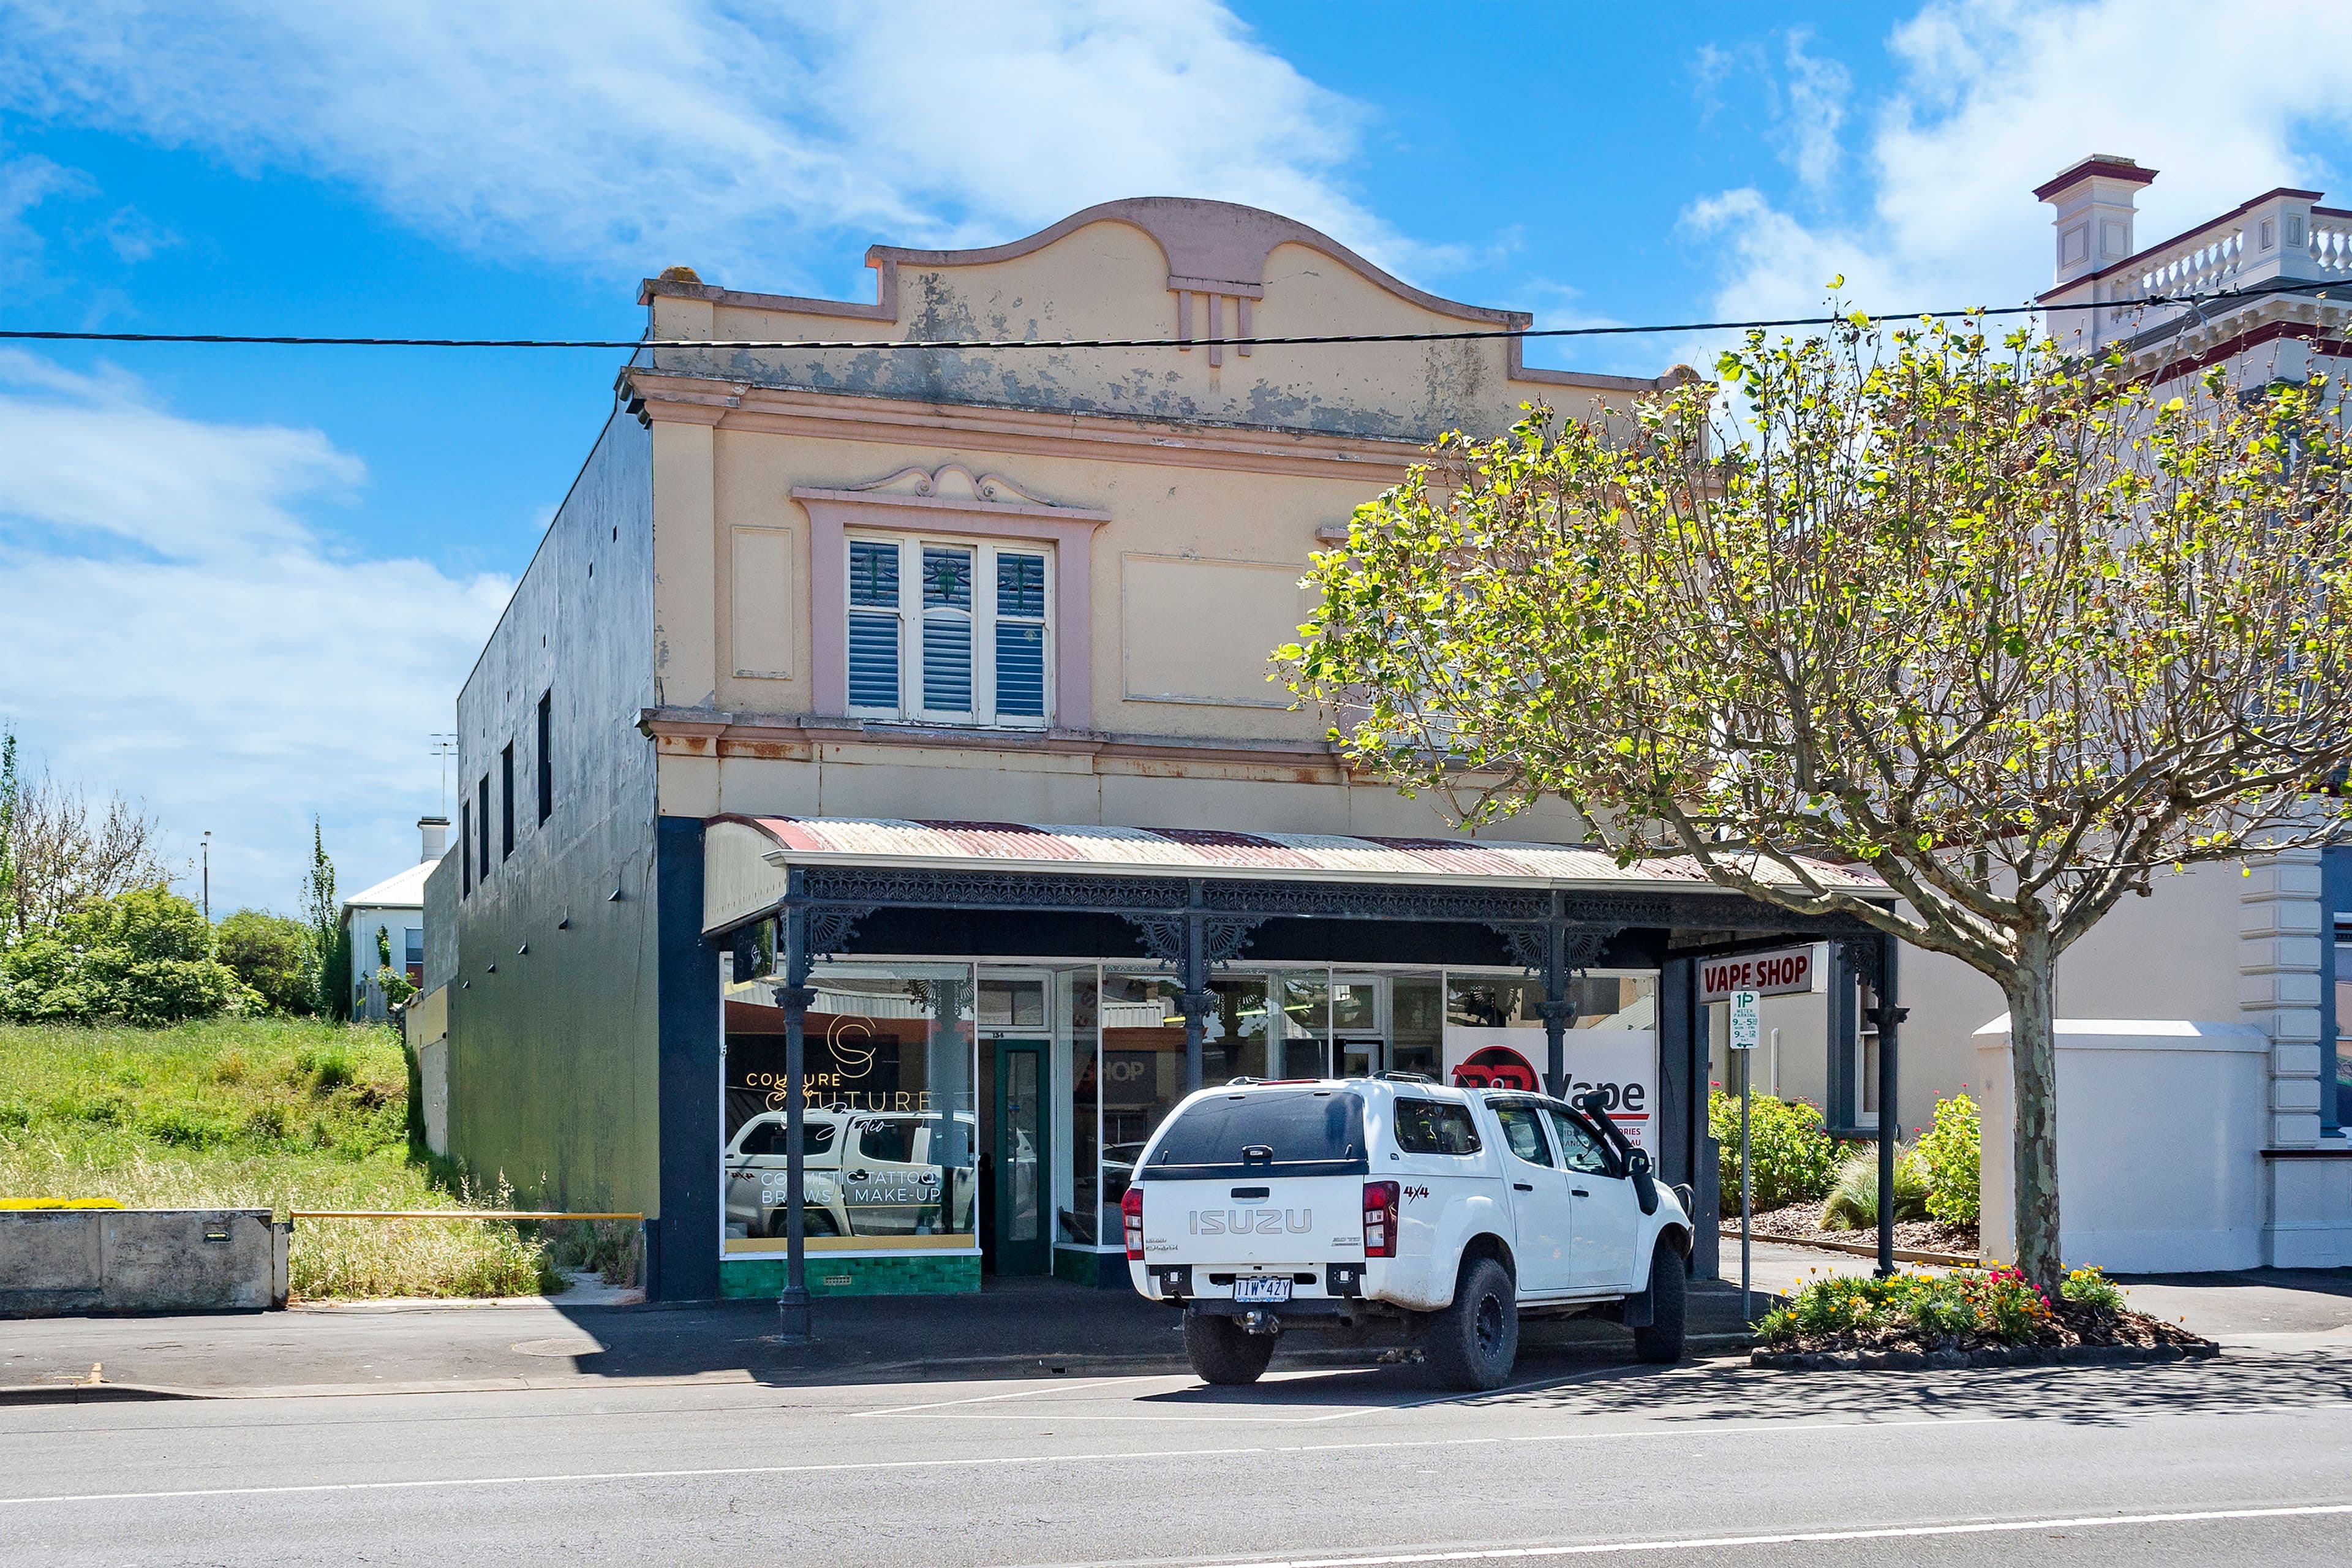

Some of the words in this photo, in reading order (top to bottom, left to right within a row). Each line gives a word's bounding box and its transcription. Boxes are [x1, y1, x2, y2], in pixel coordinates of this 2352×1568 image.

[1705, 962, 1751, 993] VAPE
[1756, 955, 1807, 987] SHOP
[1736, 993, 1754, 1008] 1P
[746, 1072, 841, 1087] COUURE
[761, 1171, 858, 1186] COMETIC
[761, 1189, 831, 1204] BRWS
[855, 1188, 941, 1202] MAKE-UP
[1189, 1208, 1312, 1235] ISUZU
[1267, 1281, 1289, 1295] 4ZY
